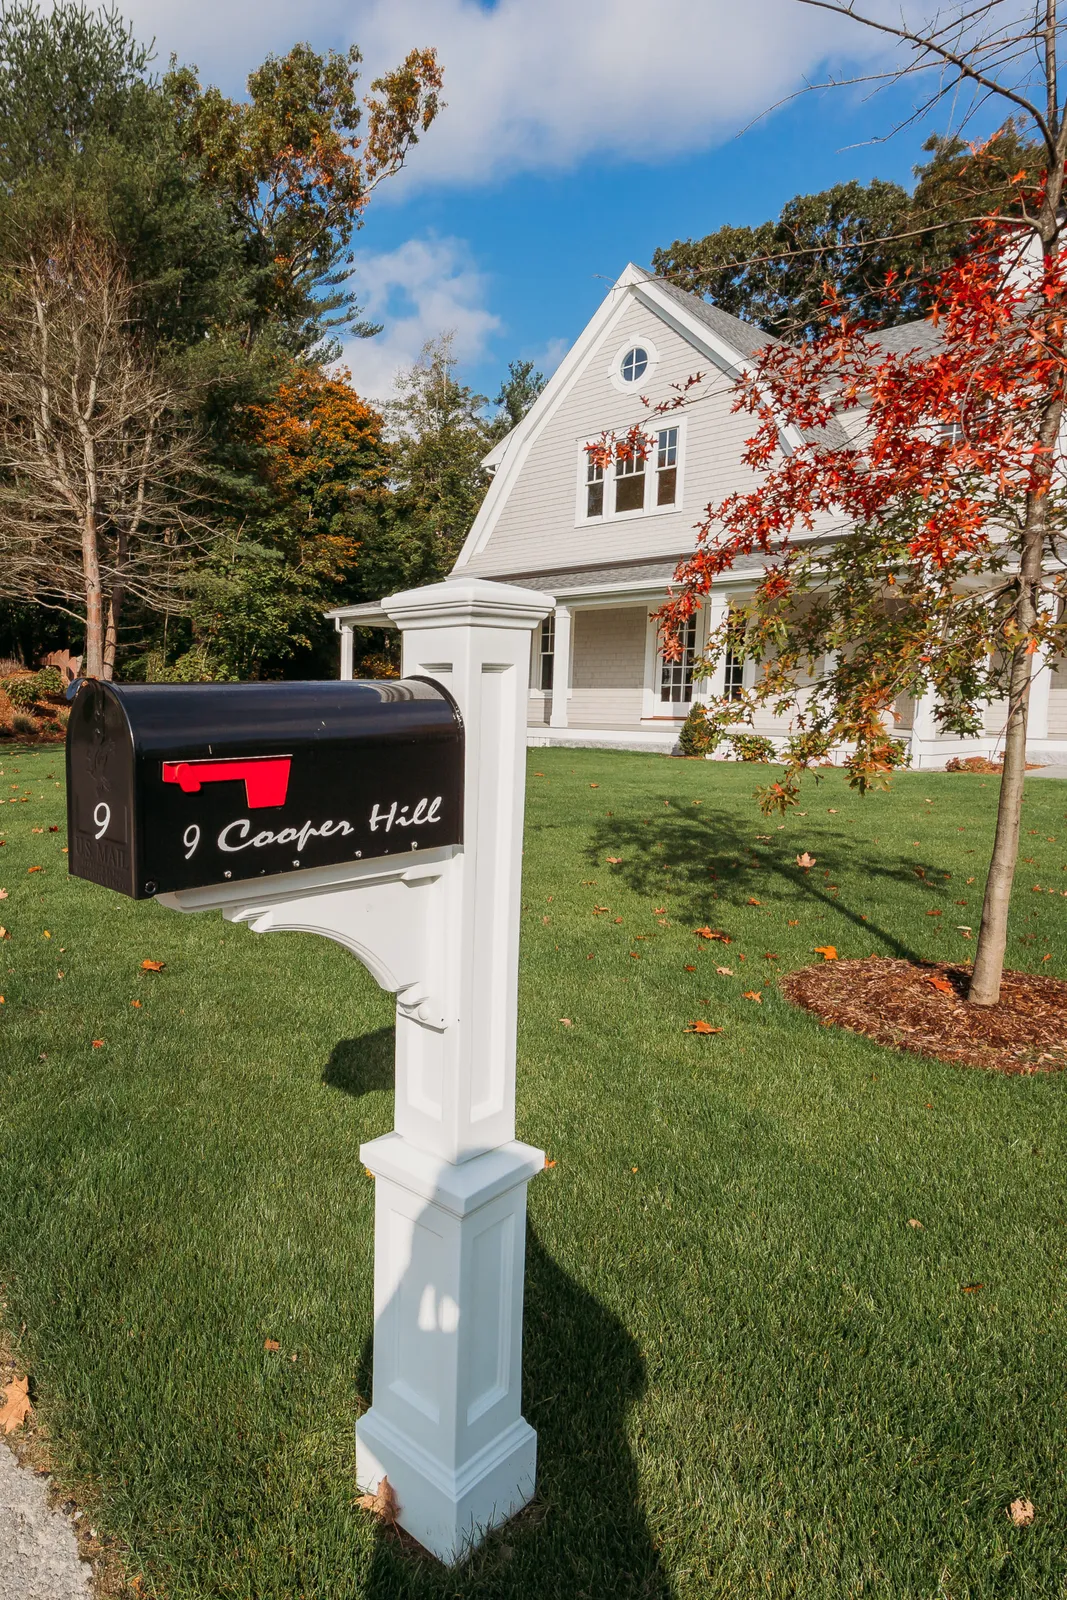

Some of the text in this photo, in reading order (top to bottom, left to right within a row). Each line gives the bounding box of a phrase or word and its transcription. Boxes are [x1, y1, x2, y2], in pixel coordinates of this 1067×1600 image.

[93, 801, 111, 839] 9
[183, 796, 442, 859] 9 Cooper Hill
[96, 842, 130, 870] MAIL
